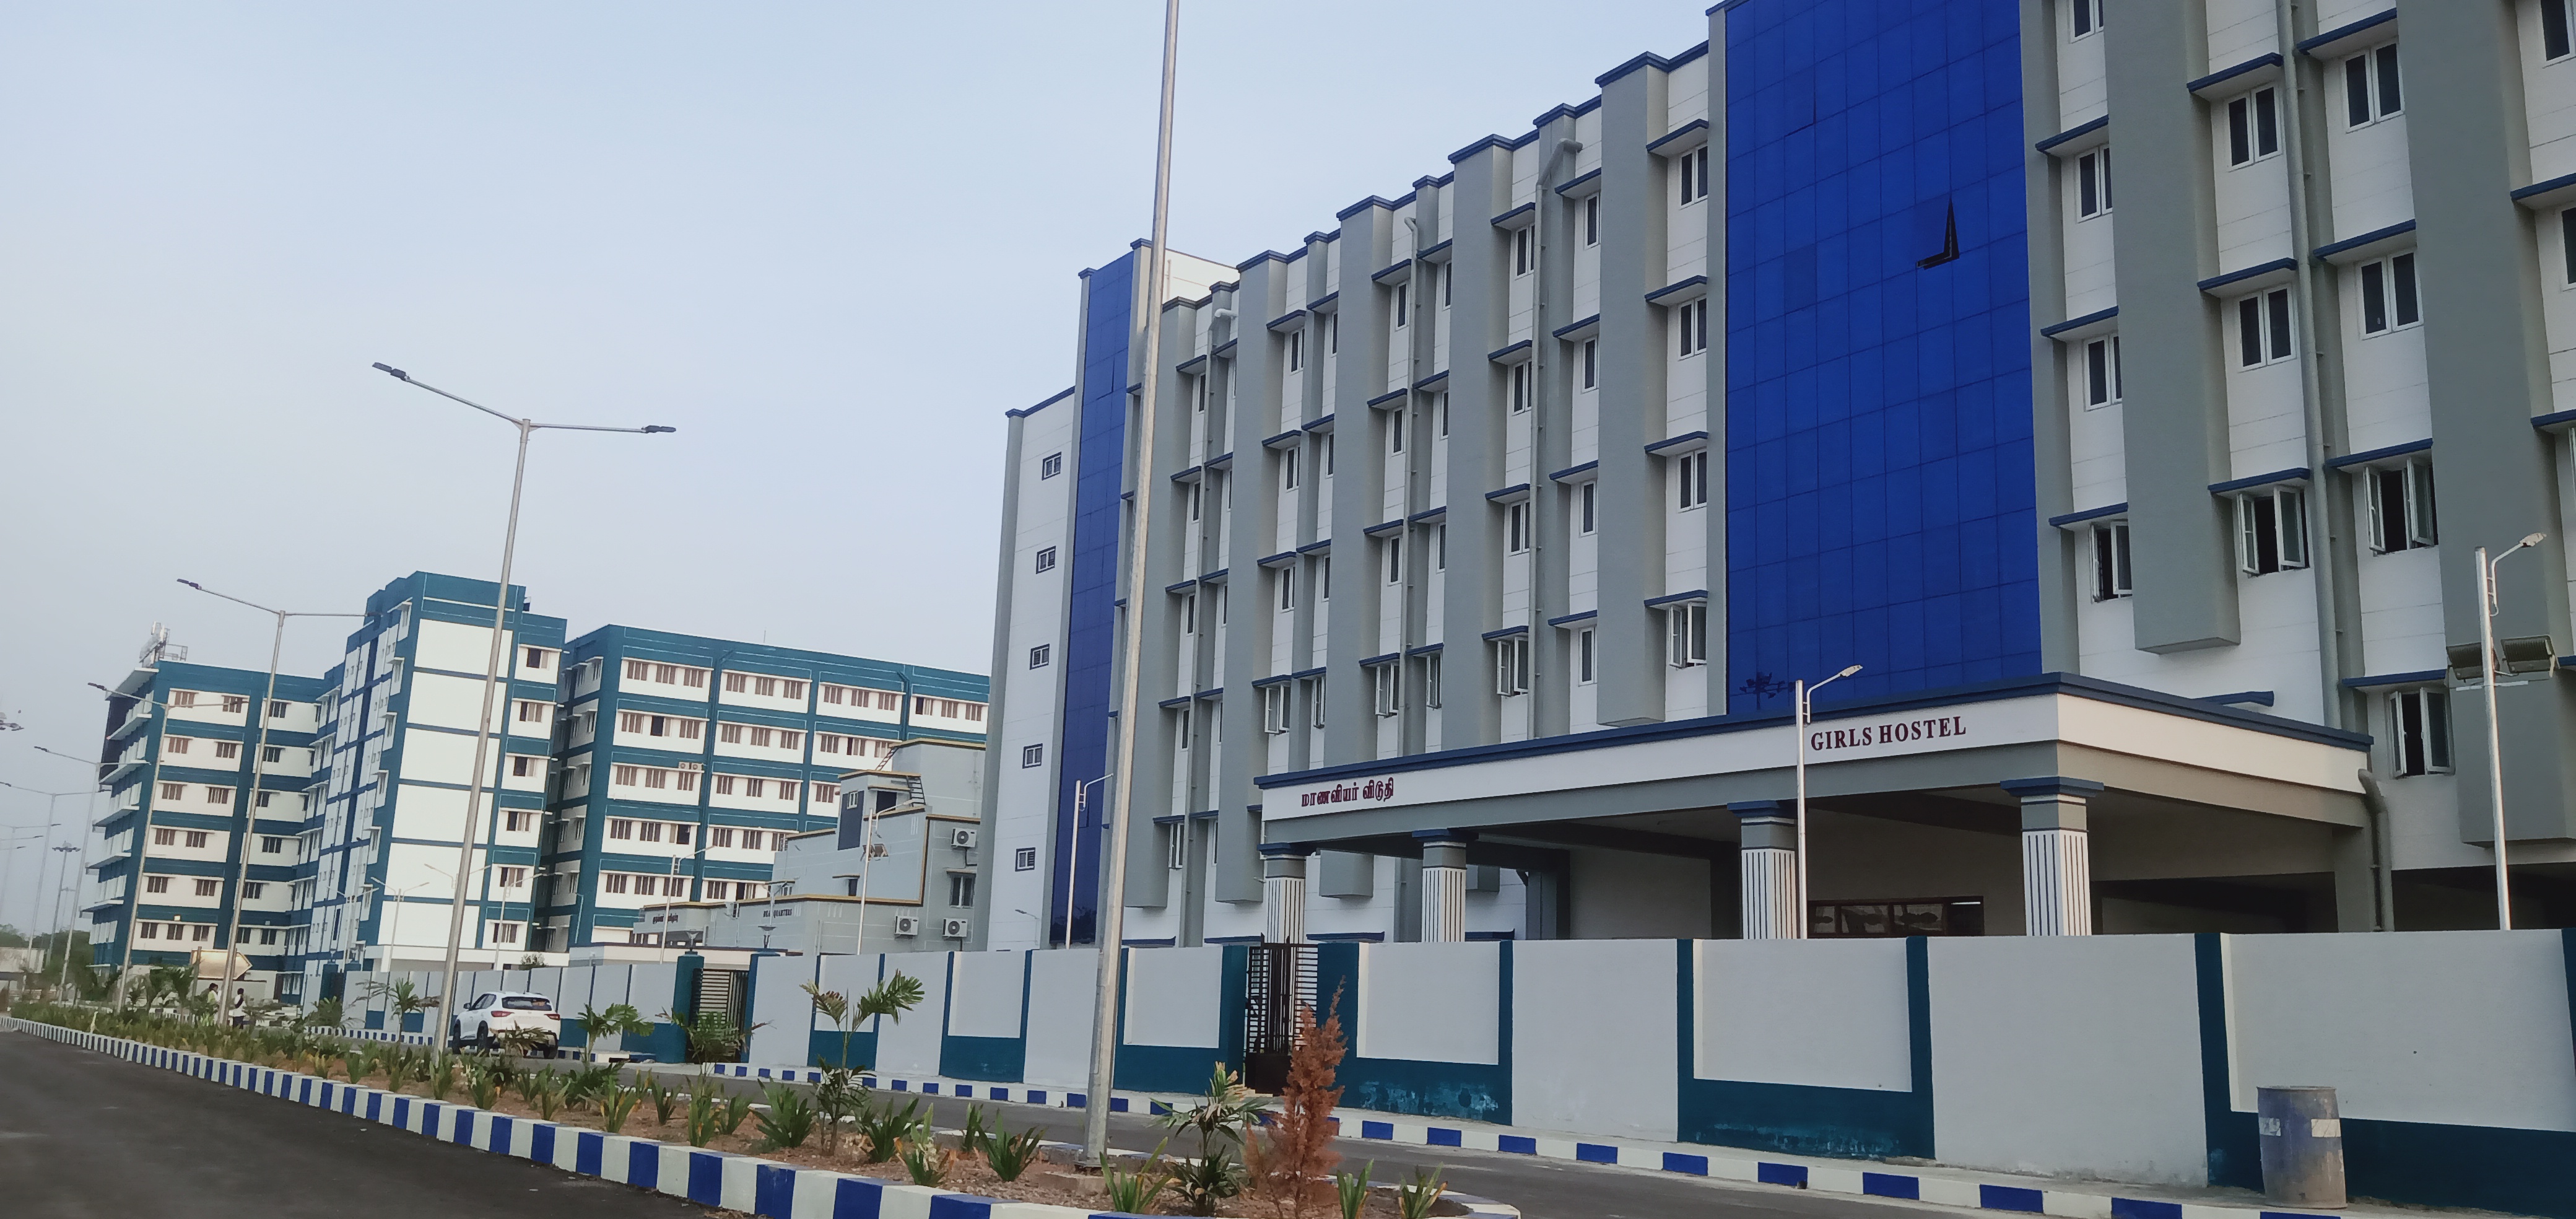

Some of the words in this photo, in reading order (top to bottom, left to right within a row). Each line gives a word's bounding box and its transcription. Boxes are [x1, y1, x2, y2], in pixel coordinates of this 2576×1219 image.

[1811, 727, 1873, 751] GIRLS
[1878, 715, 1967, 744] HOSTEL
[1301, 782, 1359, 807] மாணவியர்
[1362, 777, 1394, 802] விடுதி
